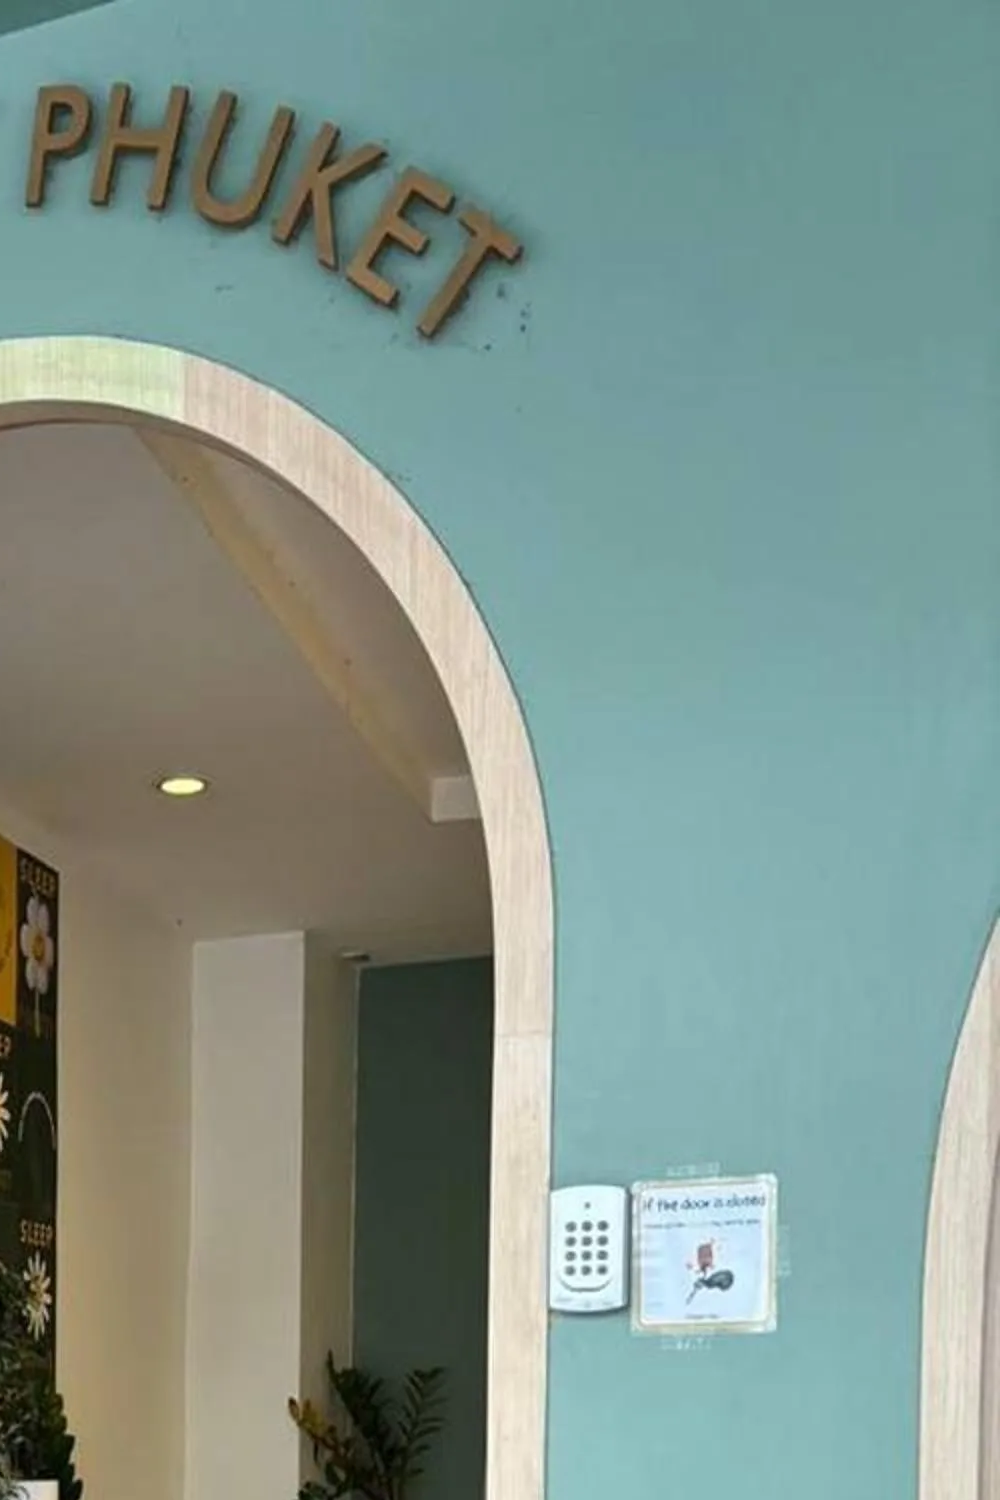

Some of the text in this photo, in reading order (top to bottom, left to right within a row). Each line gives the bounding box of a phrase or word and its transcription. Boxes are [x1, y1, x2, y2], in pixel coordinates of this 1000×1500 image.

[24, 82, 523, 339] PHUKET
[19, 857, 55, 897] SLEEP
[680, 1196, 710, 1211] door
[726, 1192, 767, 1209] closed
[20, 1219, 53, 1247] SLEEP
